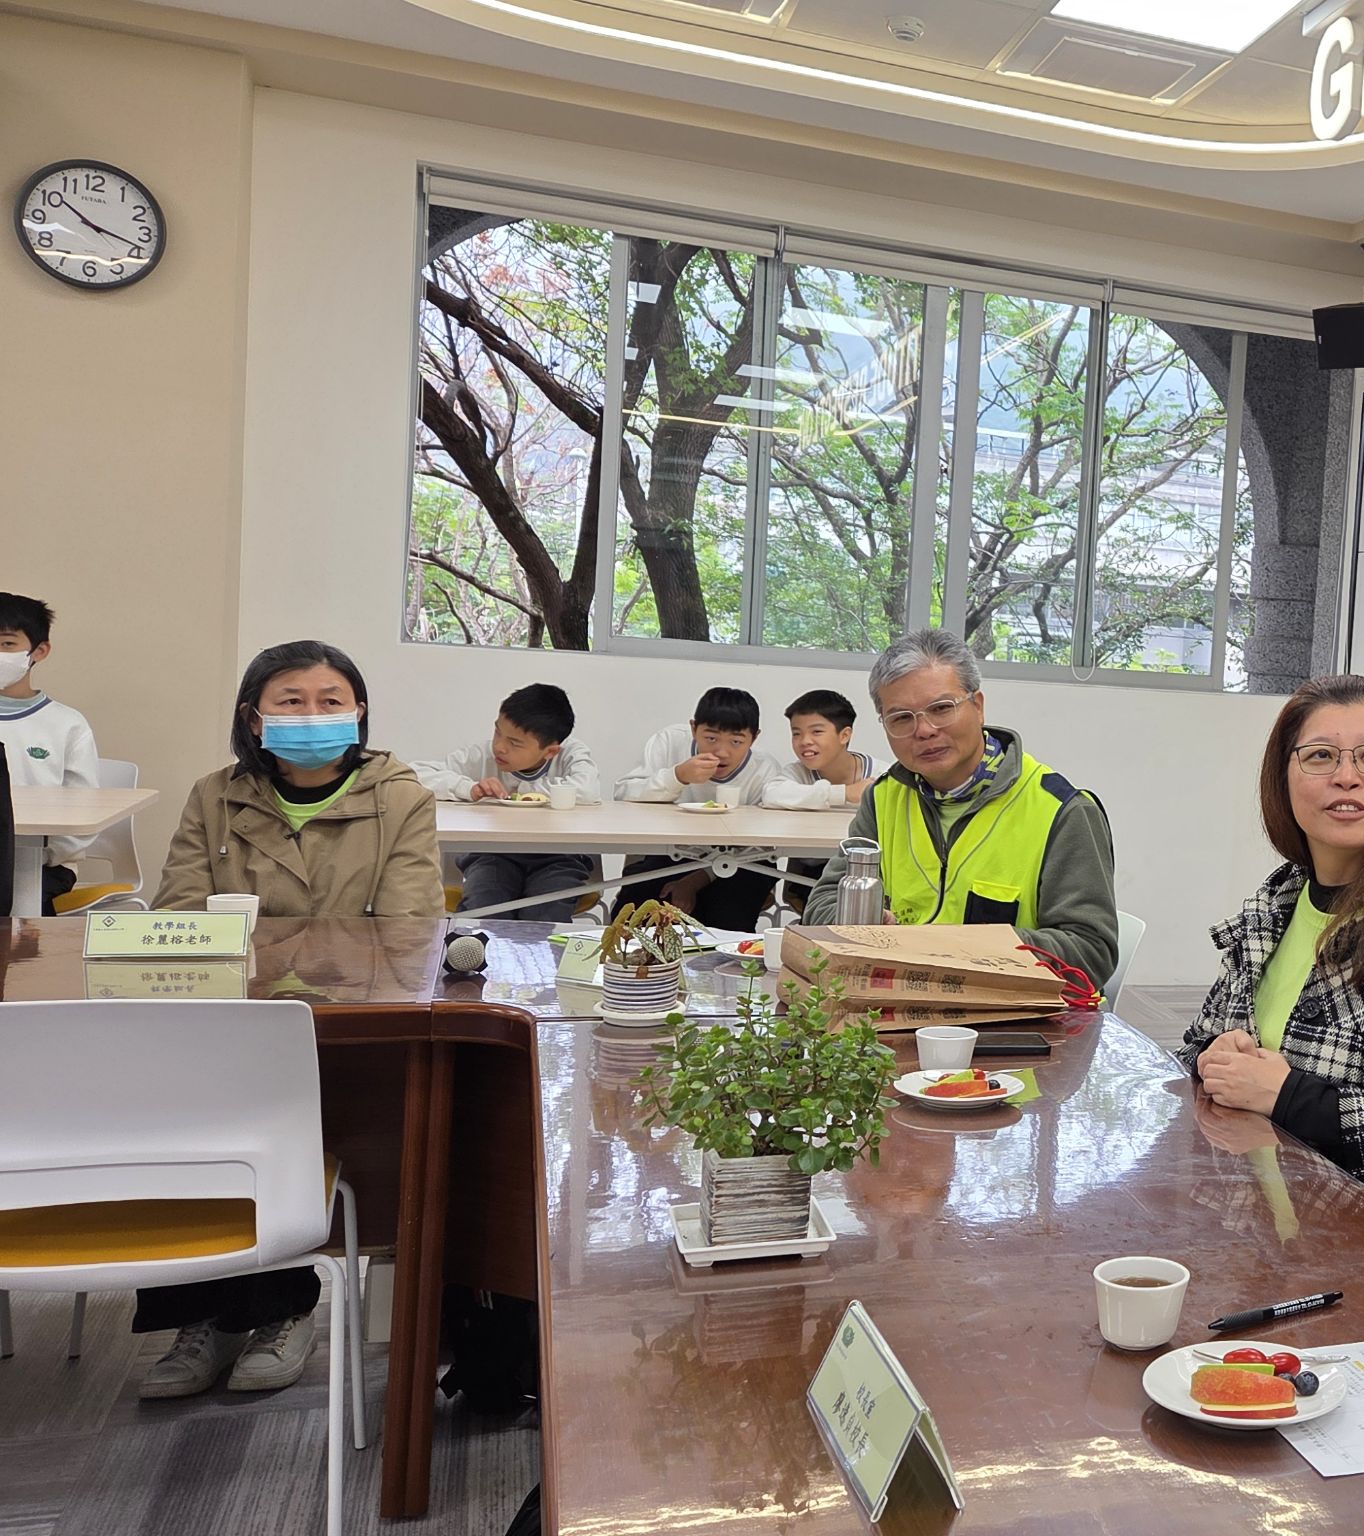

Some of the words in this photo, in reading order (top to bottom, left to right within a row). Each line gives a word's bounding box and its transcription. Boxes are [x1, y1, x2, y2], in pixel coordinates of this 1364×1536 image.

[62, 176, 77, 194] 11
[85, 174, 105, 193] 12
[41, 189, 63, 208] 10
[119, 186, 126, 203] 1
[31, 208, 46, 225] 9
[132, 205, 147, 222] 2
[38, 231, 53, 248] 8
[138, 226, 152, 243] 3
[56, 249, 71, 266] 7
[127, 246, 144, 259] 4
[82, 261, 97, 277] 6
[110, 257, 124, 275] 5
[153, 921, 198, 931] 教學組長
